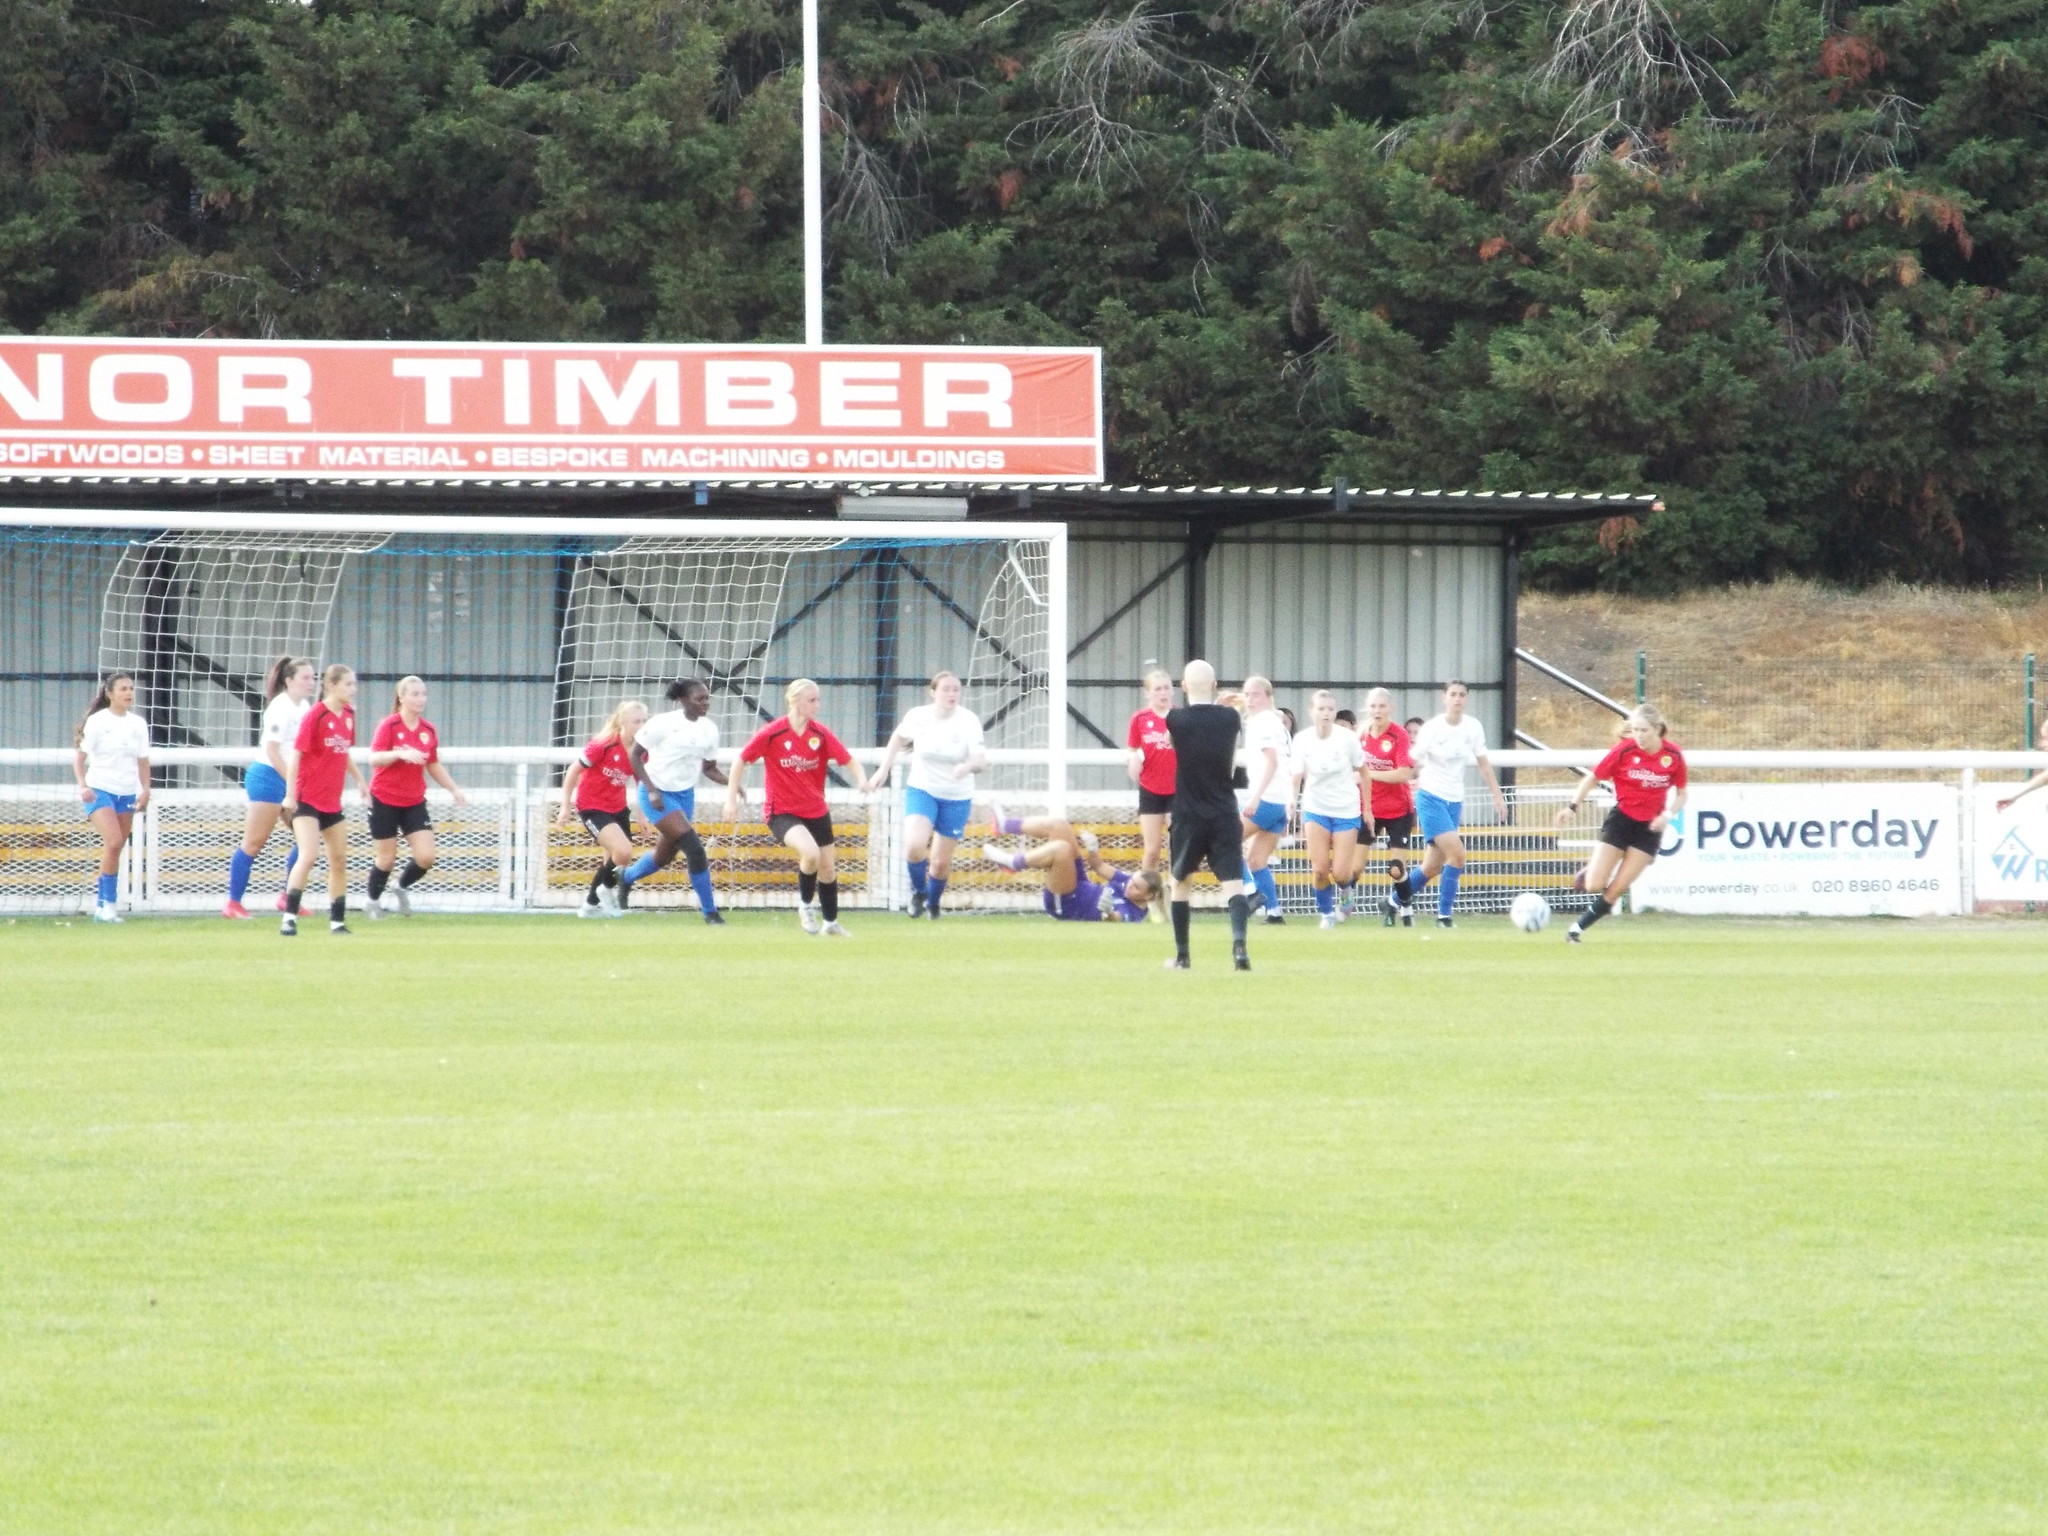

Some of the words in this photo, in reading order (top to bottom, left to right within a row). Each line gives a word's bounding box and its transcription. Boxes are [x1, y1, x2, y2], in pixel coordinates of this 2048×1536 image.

[392, 359, 1013, 428] TIMBER
[0, 443, 184, 465] SOFTWOODS
[208, 447, 306, 466] SHEET
[318, 448, 468, 467] MATERIAL
[491, 448, 628, 468] BESPOKE
[641, 448, 810, 469] MACHINING
[833, 449, 1006, 470] MOULDINGS
[1697, 808, 1939, 859] Powerday
[1698, 853, 1728, 863] YOUR
[1732, 852, 1769, 862] WASTE
[1780, 852, 1838, 862] POWERING
[1844, 851, 1862, 861] THE
[1869, 850, 1910, 860] FUTURE
[1649, 880, 1800, 896] www.powerday.co.uk
[1812, 880, 1844, 893] 020
[1897, 879, 1940, 892] 4646
